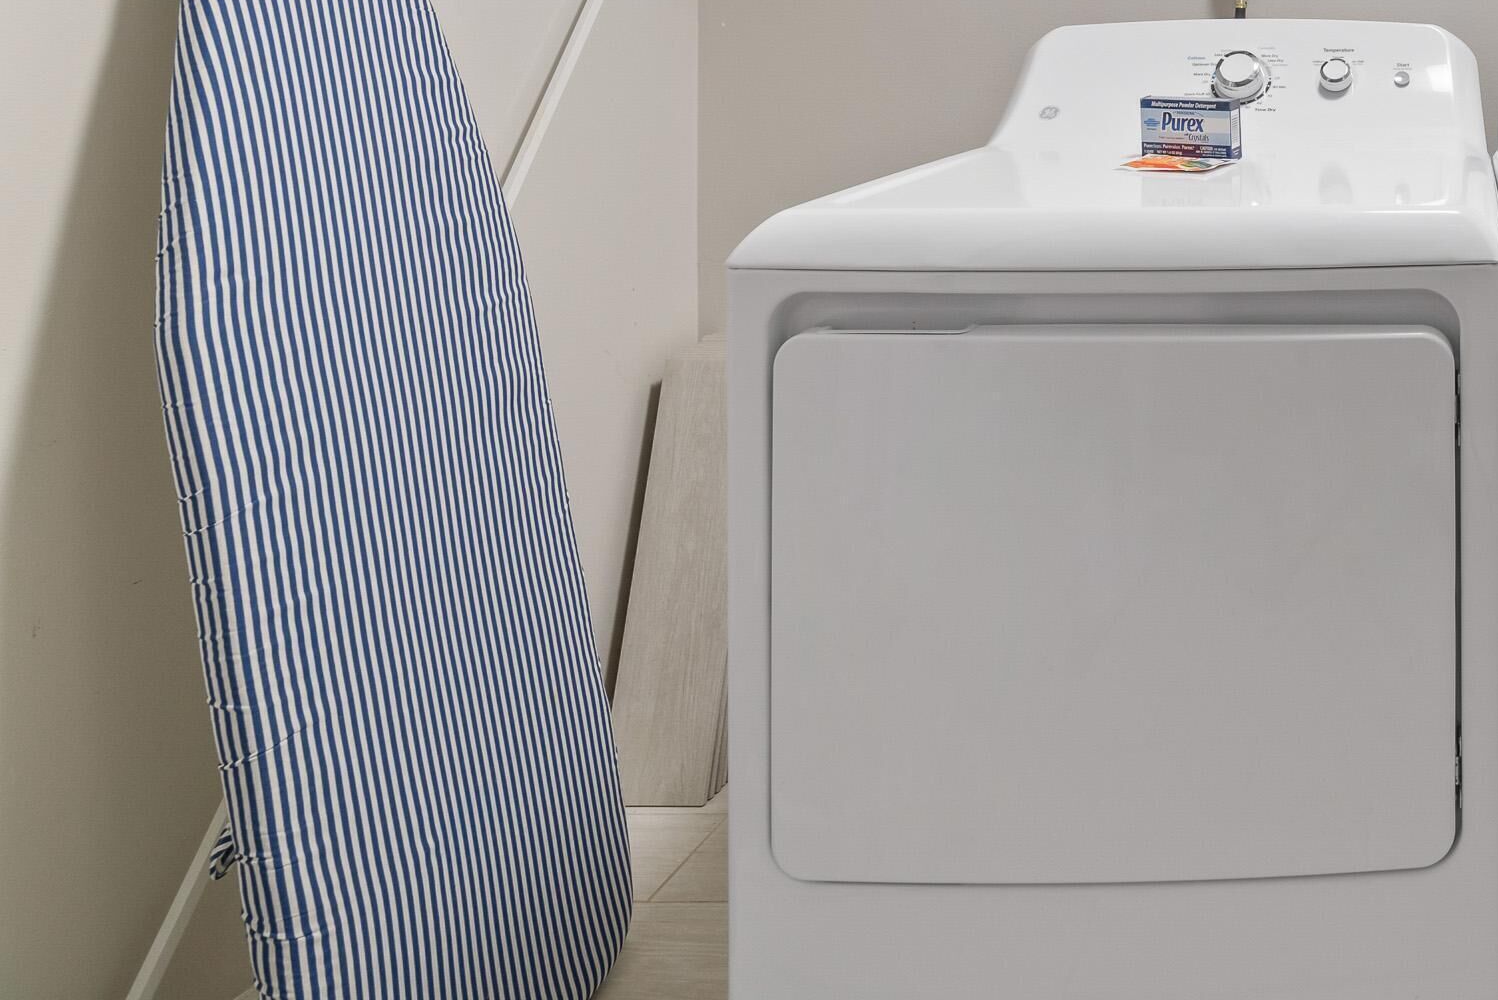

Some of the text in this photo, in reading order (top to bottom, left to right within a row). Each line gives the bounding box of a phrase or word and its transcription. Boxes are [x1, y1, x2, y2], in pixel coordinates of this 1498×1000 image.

[1151, 100, 1179, 109] Multipurpose
[1195, 102, 1217, 110] Detergent
[1161, 111, 1204, 133] Purex
[1188, 133, 1210, 142] Crystals
